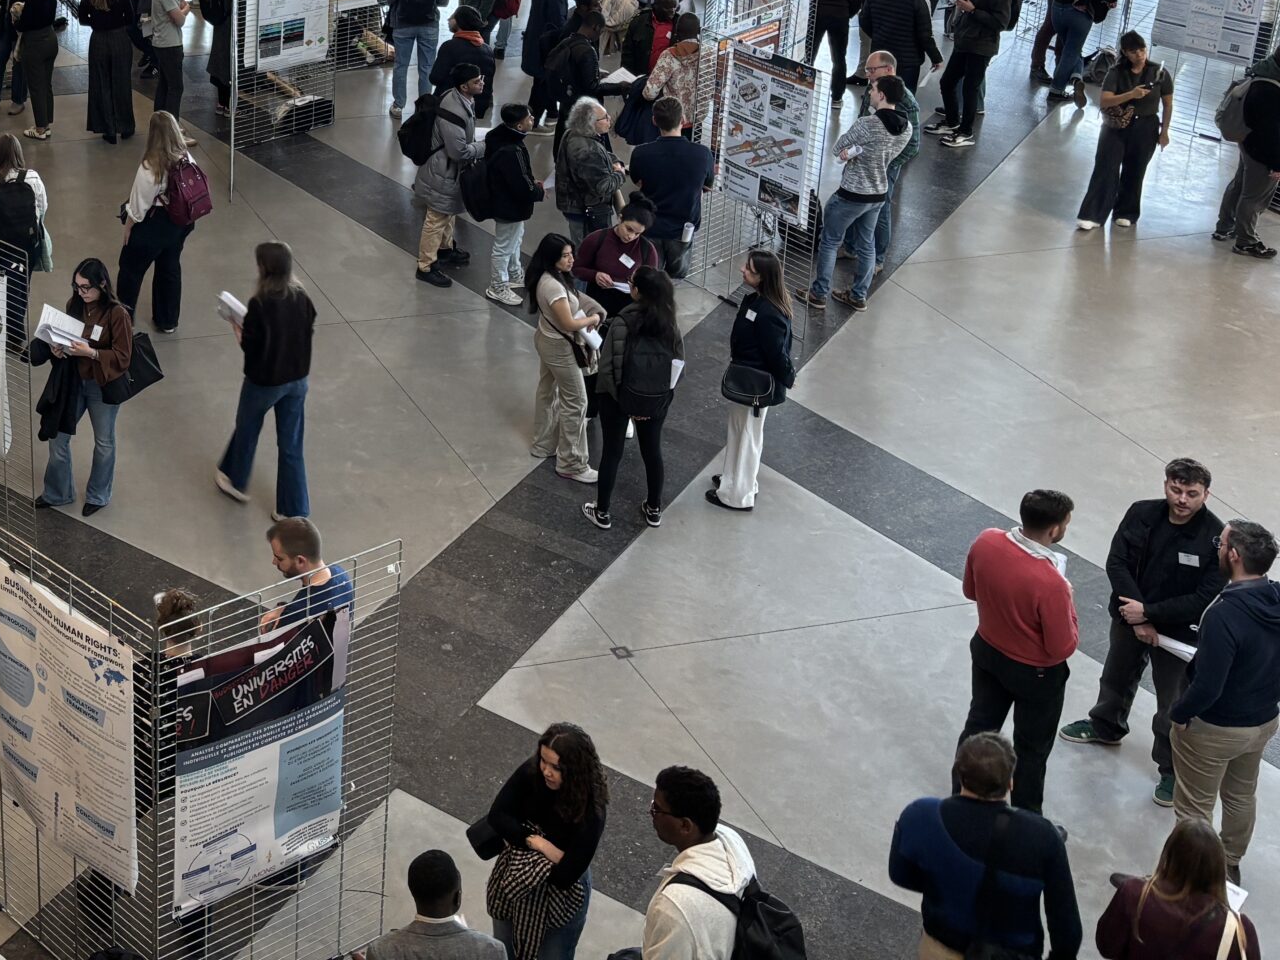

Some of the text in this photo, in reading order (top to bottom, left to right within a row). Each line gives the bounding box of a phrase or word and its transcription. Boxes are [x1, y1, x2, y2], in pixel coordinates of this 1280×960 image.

[0, 611, 36, 638] INTRODUCTION
[0, 583, 18, 598] Limits
[24, 598, 32, 609] the
[32, 605, 50, 624] Current
[50, 622, 87, 651] International
[87, 647, 126, 670] Framework
[4, 576, 121, 659] BUSINESS AND HUMAN RIGHTS:
[233, 694, 254, 714] EN
[259, 654, 314, 699] DANGER
[66, 691, 99, 716] REGULATORY
[66, 698, 100, 722] FRAMEWORK
[9, 715, 18, 725] KEY
[183, 750, 219, 766] INDIVIDUELLE
[228, 728, 281, 751] ORGANISATIONNELLE
[281, 722, 296, 731] DANS
[296, 717, 305, 725] LES
[305, 699, 341, 721] ORGANISATIONS
[191, 746, 215, 757] ANALYSE
[215, 733, 251, 750] COMPARATIVE
[263, 716, 297, 732] DYNAMIQUES
[223, 745, 251, 759] PUBLIQUES
[260, 731, 286, 745] CONTEXTE
[294, 722, 309, 731] CRISE
[180, 784, 206, 795] POURQUOI
[76, 806, 115, 837] CONCLUSIONS
[248, 865, 276, 881] UMONS
